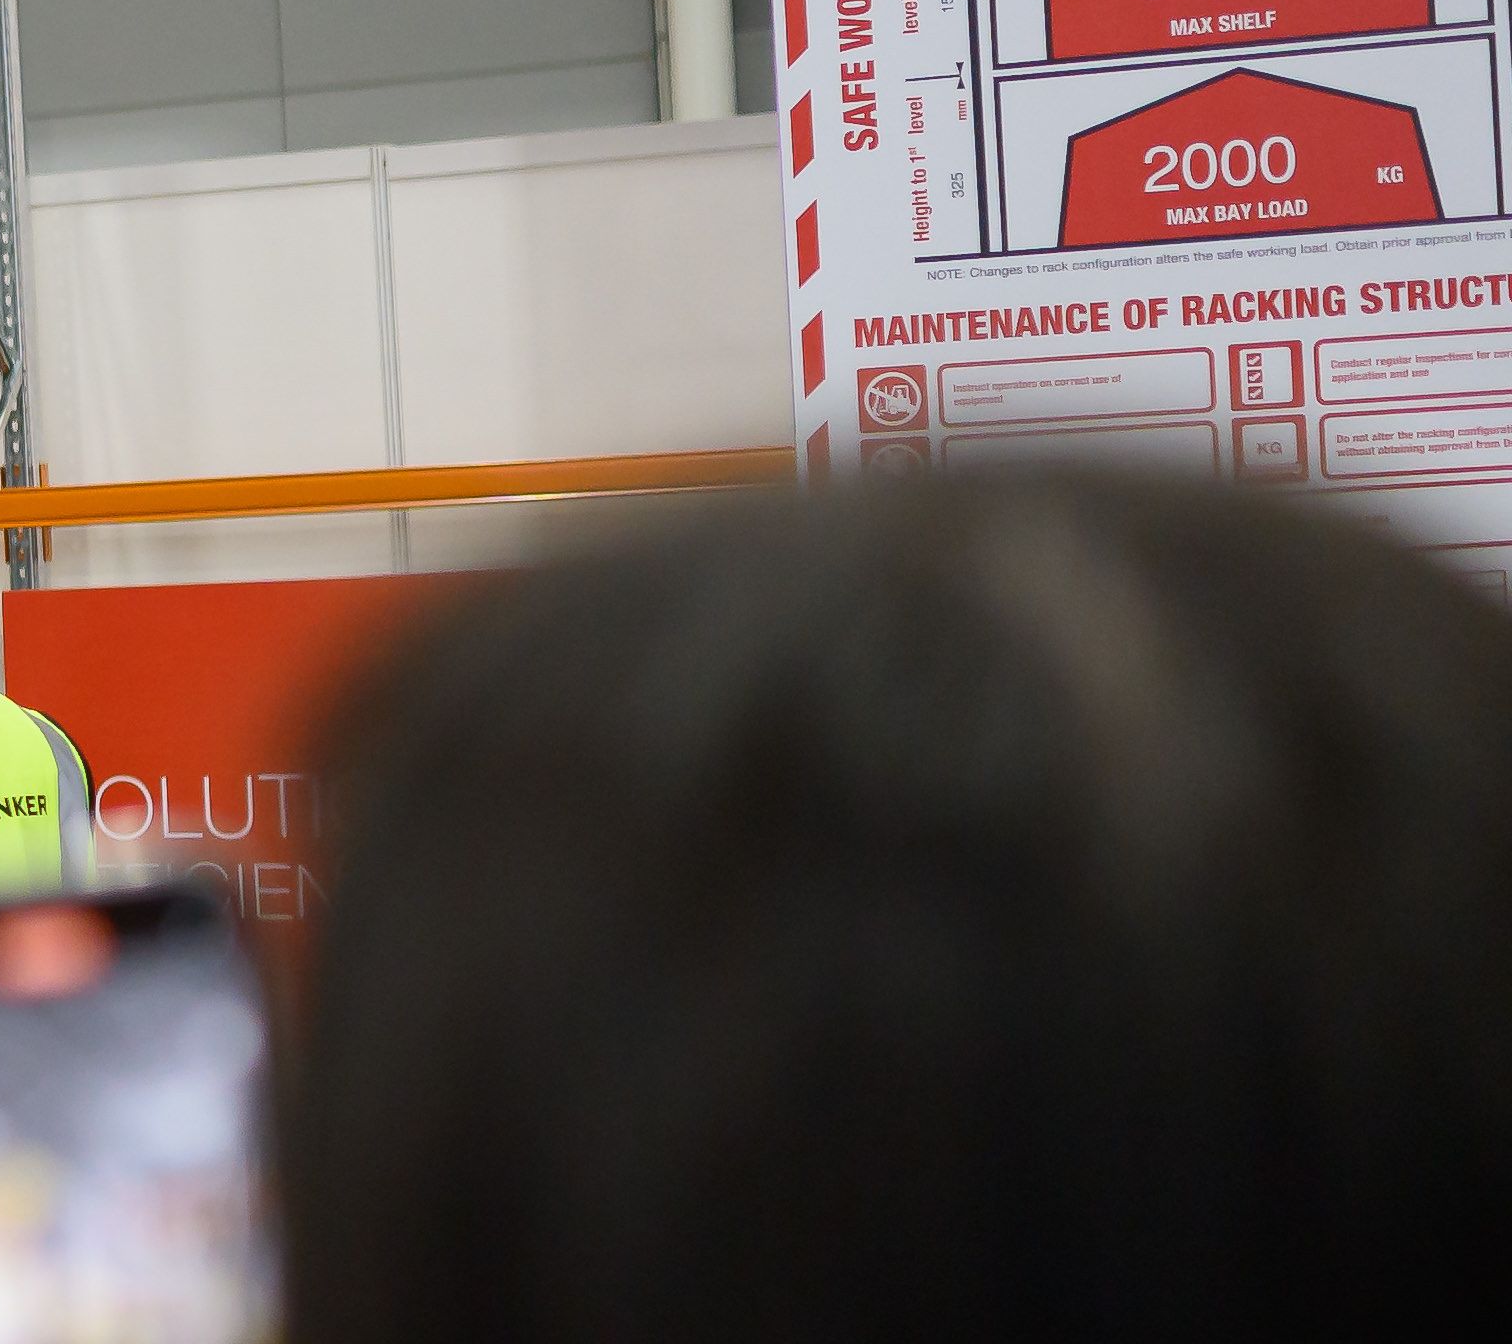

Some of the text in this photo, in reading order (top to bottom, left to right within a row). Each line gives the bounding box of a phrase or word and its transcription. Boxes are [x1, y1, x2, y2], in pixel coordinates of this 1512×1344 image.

[1170, 11, 1277, 36] MAX SHELF
[840, 60, 880, 151] SAFE
[906, 96, 924, 135] level
[957, 100, 967, 121] mm
[911, 168, 927, 184] to
[1143, 136, 1404, 193] 2000 KG
[951, 172, 964, 199] 325
[912, 189, 933, 242] Height
[1166, 199, 1308, 226] MAX BAY LOAD
[969, 265, 1023, 279] Changes
[1027, 264, 1039, 274] to
[1042, 262, 1068, 273] rack
[1072, 256, 1152, 272] configuration
[1156, 253, 1190, 264] alters
[1193, 251, 1214, 261] the
[1217, 248, 1243, 260] safe
[1247, 244, 1297, 259] working
[1300, 243, 1331, 255] load.
[1335, 239, 1378, 251] Obtain
[1382, 236, 1411, 250] prior
[1416, 232, 1471, 247] approval
[1476, 230, 1506, 242] from
[854, 273, 1512, 348] MAINTENANCE OF RACKING STRUCT
